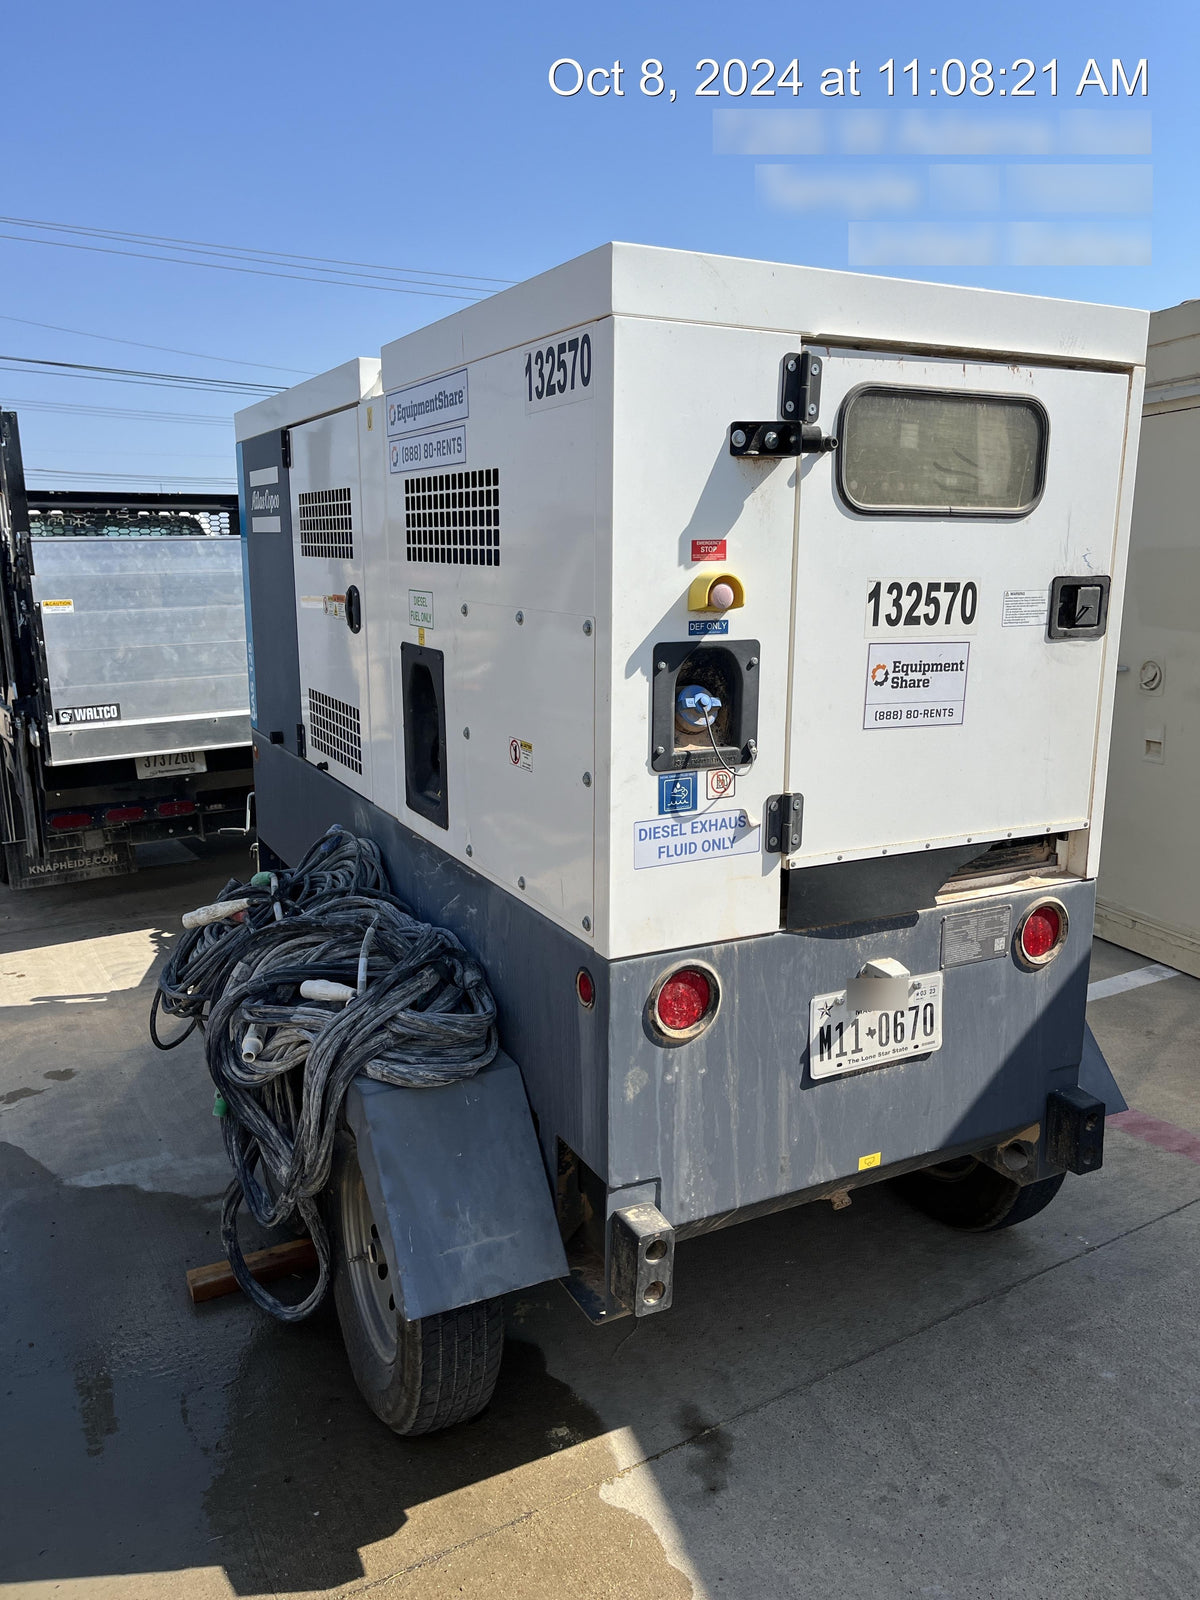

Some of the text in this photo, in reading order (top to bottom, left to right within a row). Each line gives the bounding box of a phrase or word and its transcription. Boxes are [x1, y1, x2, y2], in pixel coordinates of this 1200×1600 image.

[525, 334, 591, 401] 132570
[396, 389, 463, 423] EquipmentShare
[402, 437, 462, 464] (888) 80-RENTS
[413, 596, 428, 608] DIESEL
[867, 581, 978, 627] 132570
[410, 610, 432, 624] FUEL ONLY
[689, 622, 728, 631] DEF ONLY
[892, 660, 965, 676] Equipment
[890, 676, 931, 690] Share
[74, 705, 118, 721] WALTCO
[874, 708, 955, 722] (888) 80-RENTS
[638, 815, 747, 842] DIESEL EXHAUS
[658, 836, 737, 859] FLUID ONLY
[28, 854, 119, 875] KNAPHEIDE.COM
[819, 1002, 935, 1063] M11 0670
[861, 1053, 877, 1062] Lone
[878, 1050, 891, 1058] Star
[892, 1046, 909, 1054] State
